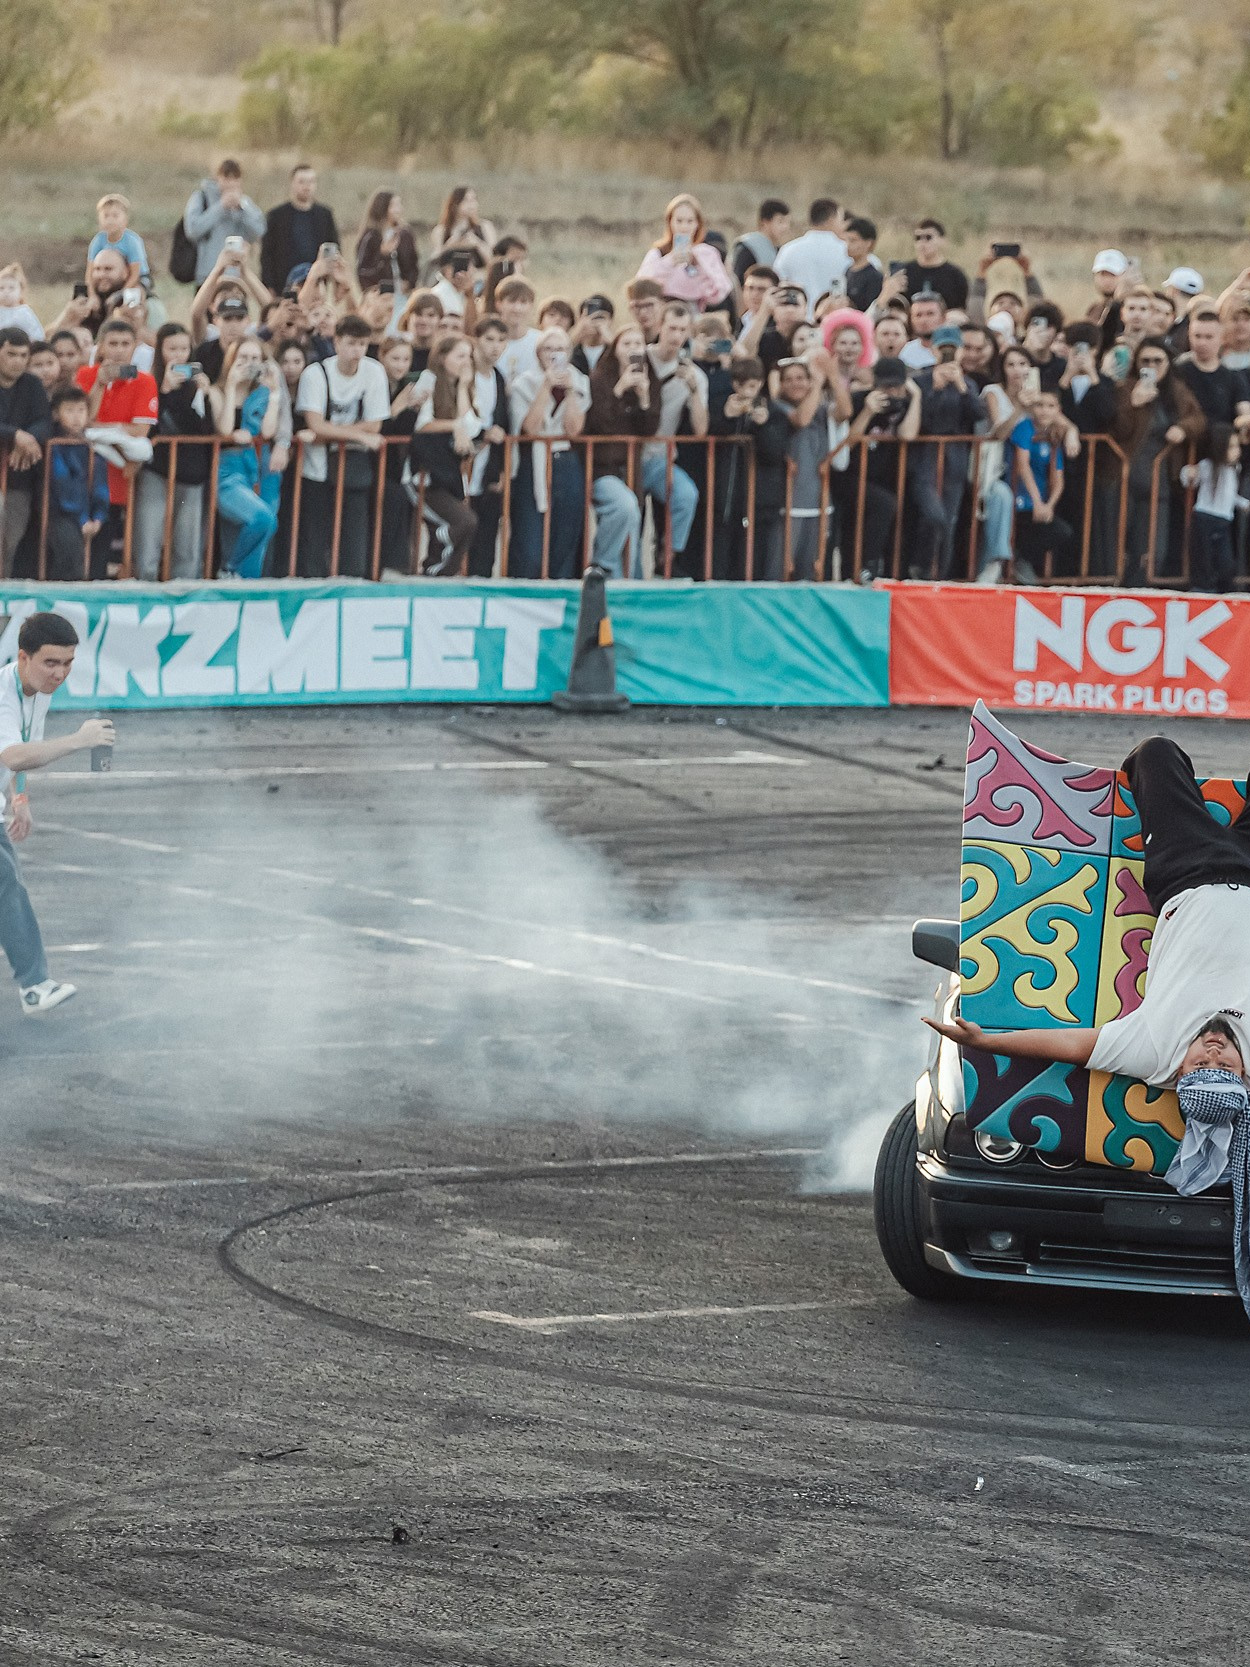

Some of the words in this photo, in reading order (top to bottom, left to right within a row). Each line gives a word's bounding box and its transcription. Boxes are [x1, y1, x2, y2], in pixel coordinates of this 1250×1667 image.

[1013, 595, 1233, 683] NGK
[1013, 680, 1117, 710] SPARK
[1122, 685, 1229, 715] PLUGS
